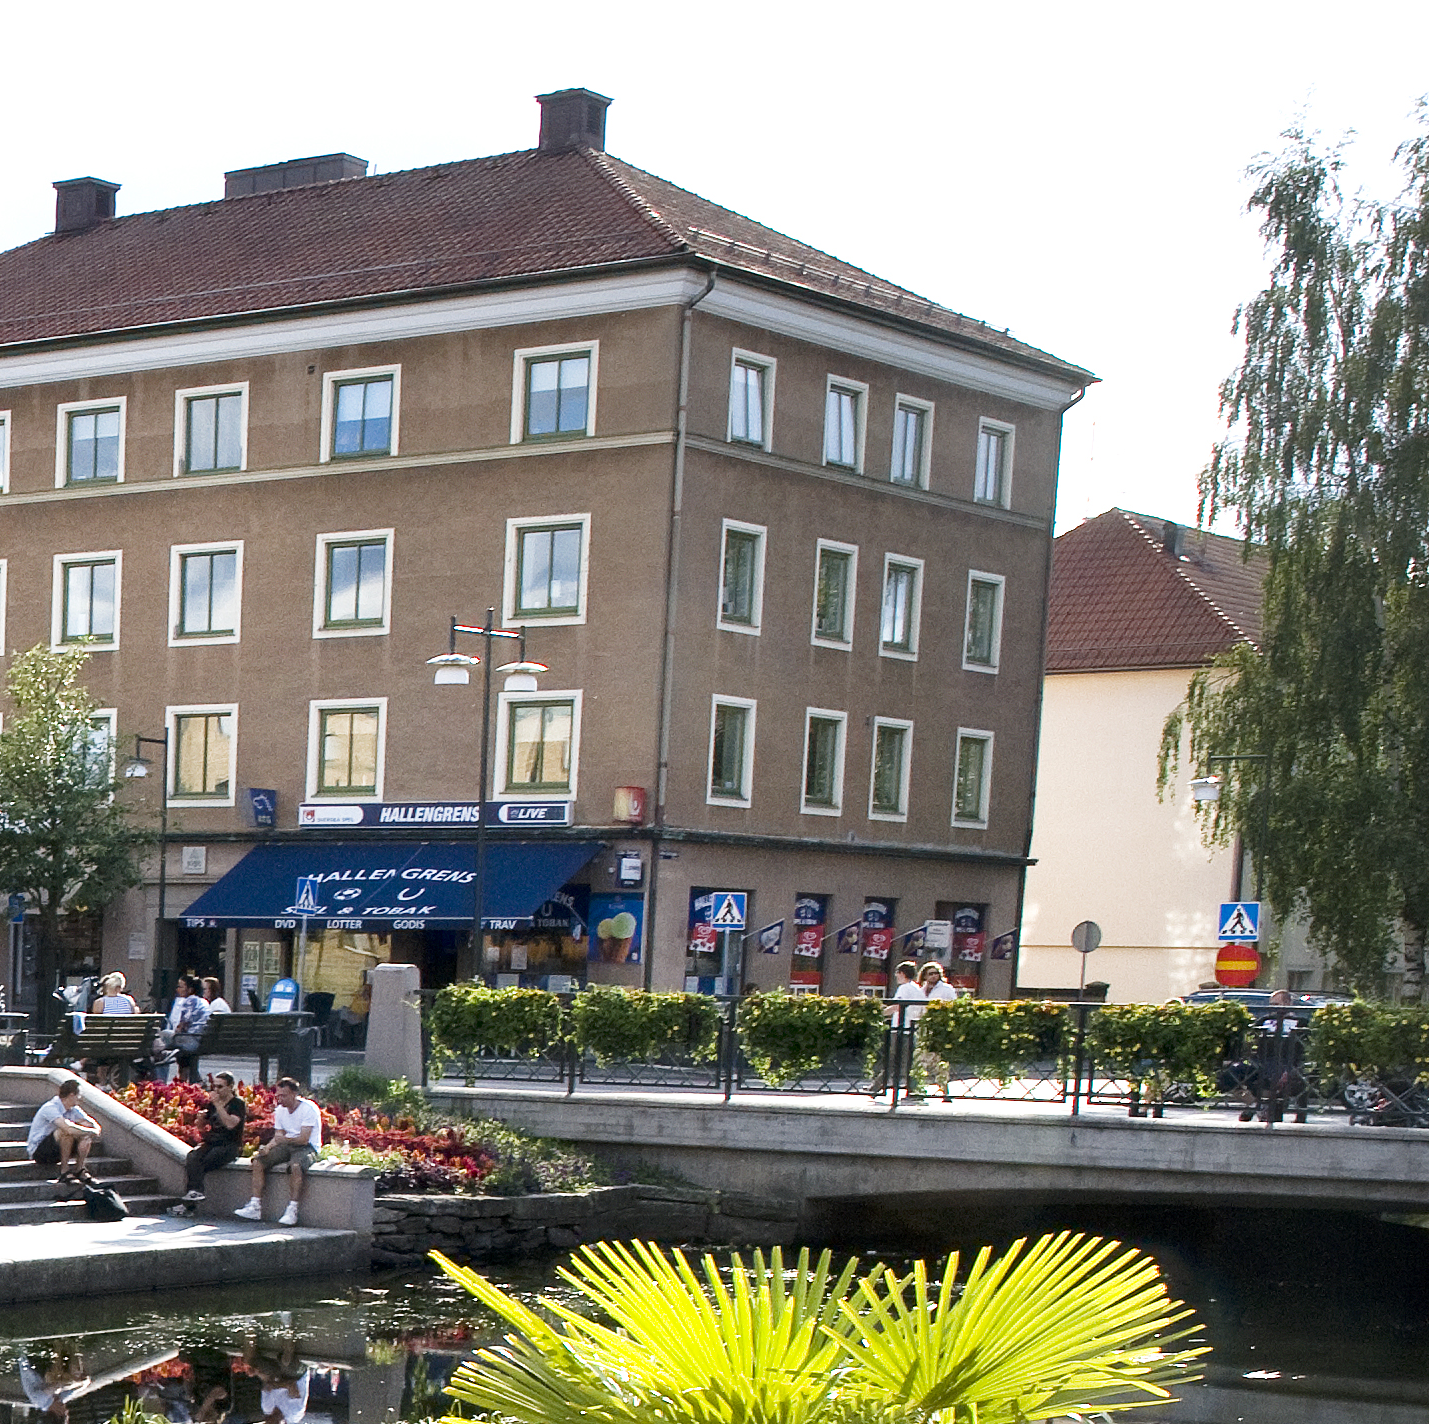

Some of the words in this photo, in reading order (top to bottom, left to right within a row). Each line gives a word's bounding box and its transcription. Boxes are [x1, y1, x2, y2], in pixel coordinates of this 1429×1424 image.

[379, 806, 480, 823] HALLENGRENS
[517, 808, 548, 819] LIVE
[281, 905, 328, 915] SL
[337, 906, 354, 915] &
[362, 905, 437, 915] TOBAK
[186, 918, 205, 928] TIPS
[274, 919, 296, 929] DVD
[326, 919, 363, 929] LOTTER
[393, 919, 426, 930] GODIS
[489, 919, 517, 930] TRAV
